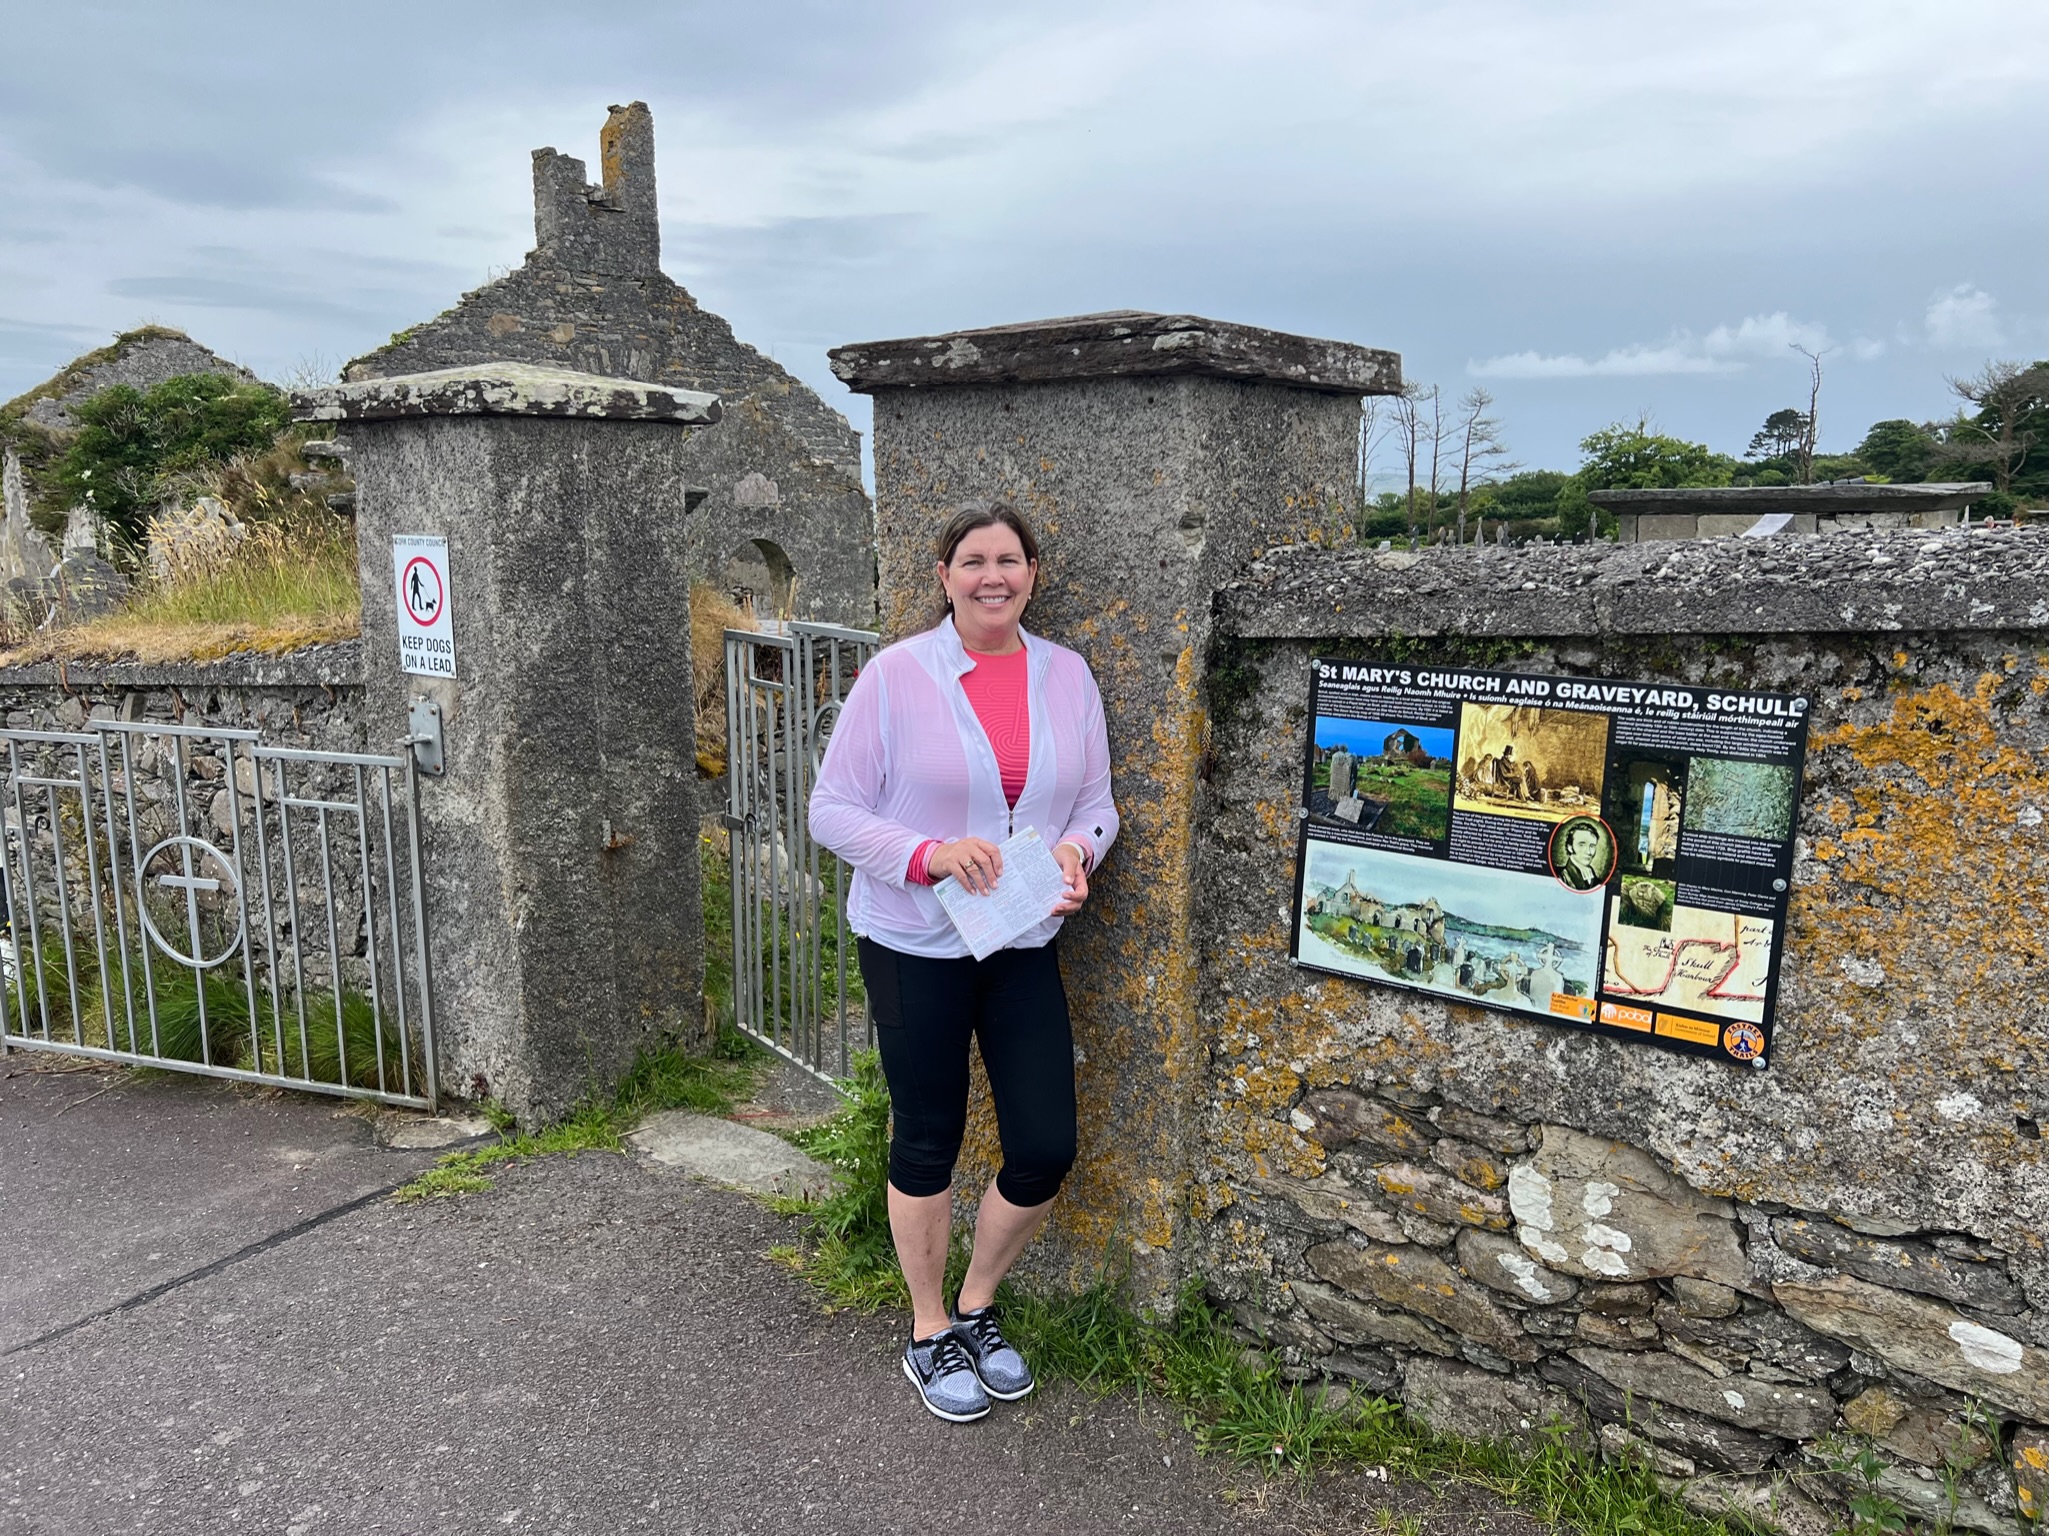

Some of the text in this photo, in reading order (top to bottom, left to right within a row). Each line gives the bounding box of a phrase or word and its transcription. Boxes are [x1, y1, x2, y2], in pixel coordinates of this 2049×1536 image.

[407, 538, 425, 546] COUNTY
[402, 635, 451, 654] KEEP DOGS
[405, 654, 451, 673] ON A LEAD
[1319, 664, 1803, 717] St MARY'S CHURCH AND GRAVEYARD, SCHULL
[1318, 680, 1360, 691] Seaneaglais
[1381, 685, 1402, 694] Reilig
[1404, 687, 1431, 695] Naomh
[1433, 690, 1460, 698] Mhuire
[1508, 696, 1543, 707] eaglaise
[1645, 707, 1654, 715] le
[1656, 708, 1679, 719] reilig
[1784, 719, 1799, 727] air
[1681, 955, 1712, 971] Skull
[1674, 967, 1715, 984] Harbour
[1618, 1005, 1652, 1026] pobal
[1727, 1023, 1763, 1040] FASTNET
[1728, 1045, 1759, 1060] TRAILS
